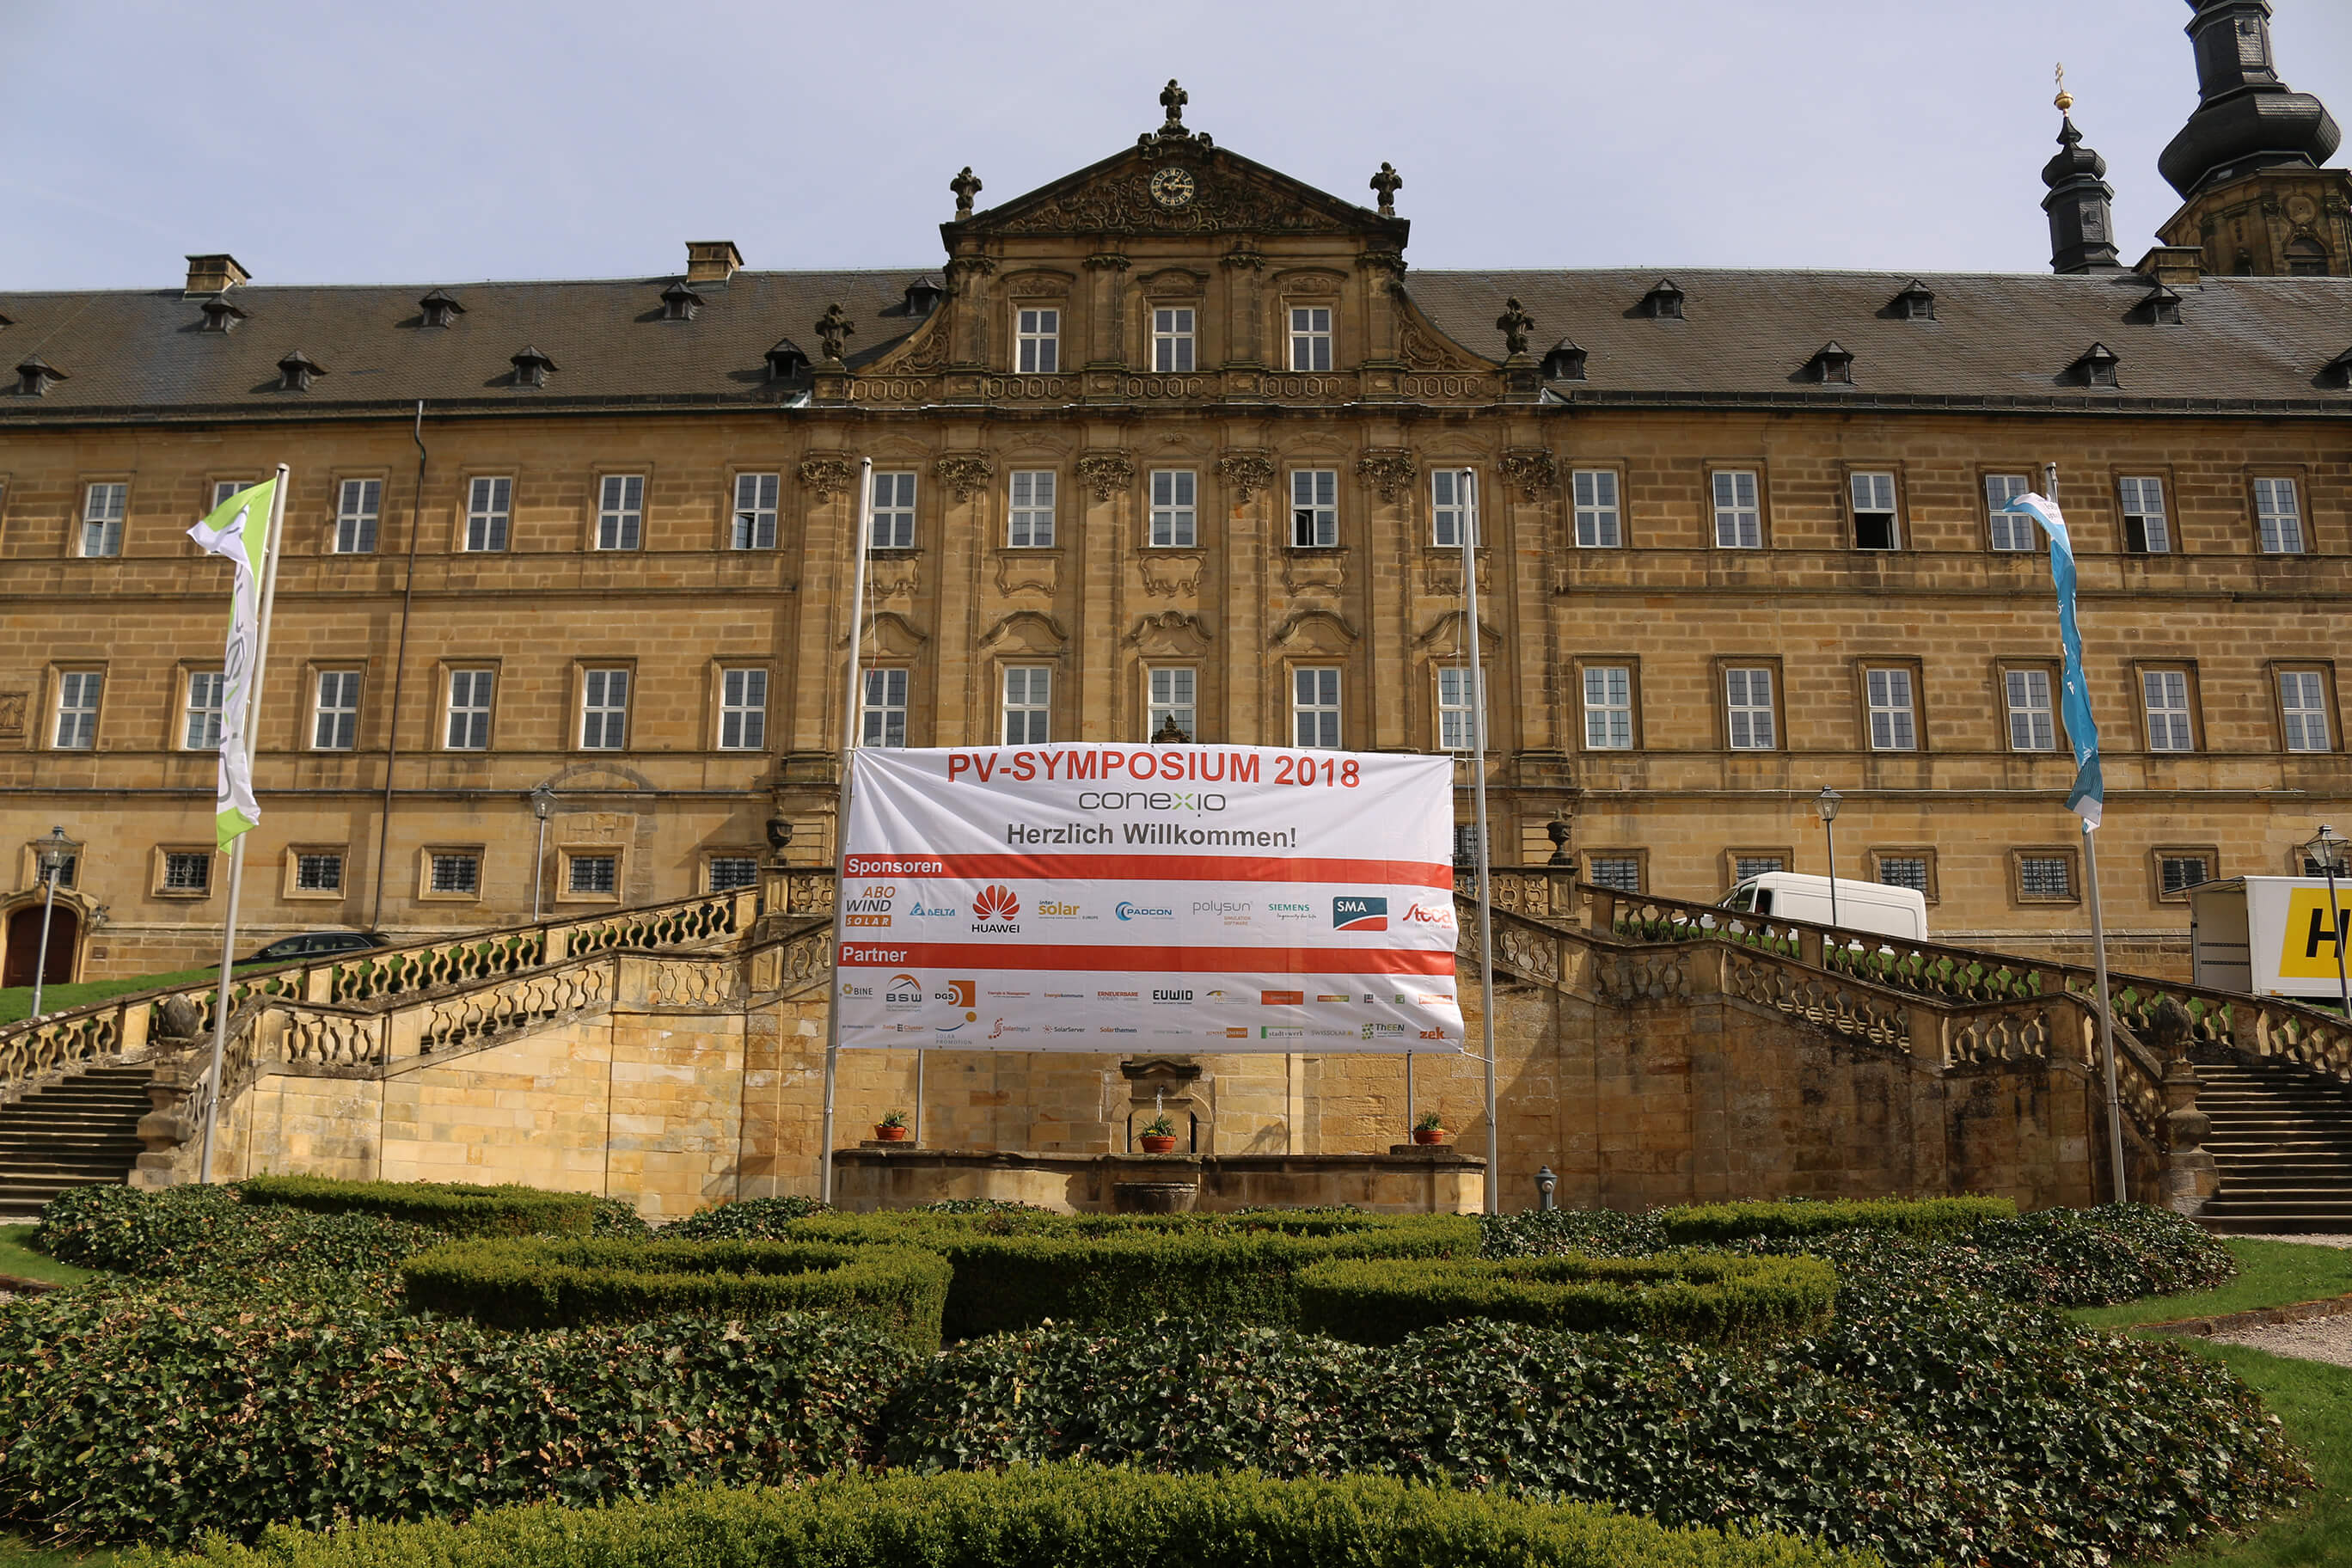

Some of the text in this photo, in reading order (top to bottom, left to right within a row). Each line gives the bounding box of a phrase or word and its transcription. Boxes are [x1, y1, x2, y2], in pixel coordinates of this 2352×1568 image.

[947, 750, 1360, 787] PV-SYMPOSIUM 2018
[1007, 824, 1296, 848] Herzlich Willkommen!
[848, 859, 942, 876] Sponsoren
[862, 886, 896, 898] ABO
[846, 900, 891, 912] WIND
[1038, 902, 1080, 916] solar
[1192, 901, 1251, 916] polysun
[1337, 901, 1367, 912] SMA
[846, 916, 890, 926] SOLAR
[971, 924, 1020, 934] HUAWEI
[842, 946, 907, 962] Partner
[886, 994, 922, 1002] BSW
[1153, 990, 1193, 1001] EUWID
[1420, 1026, 1445, 1038] zek
